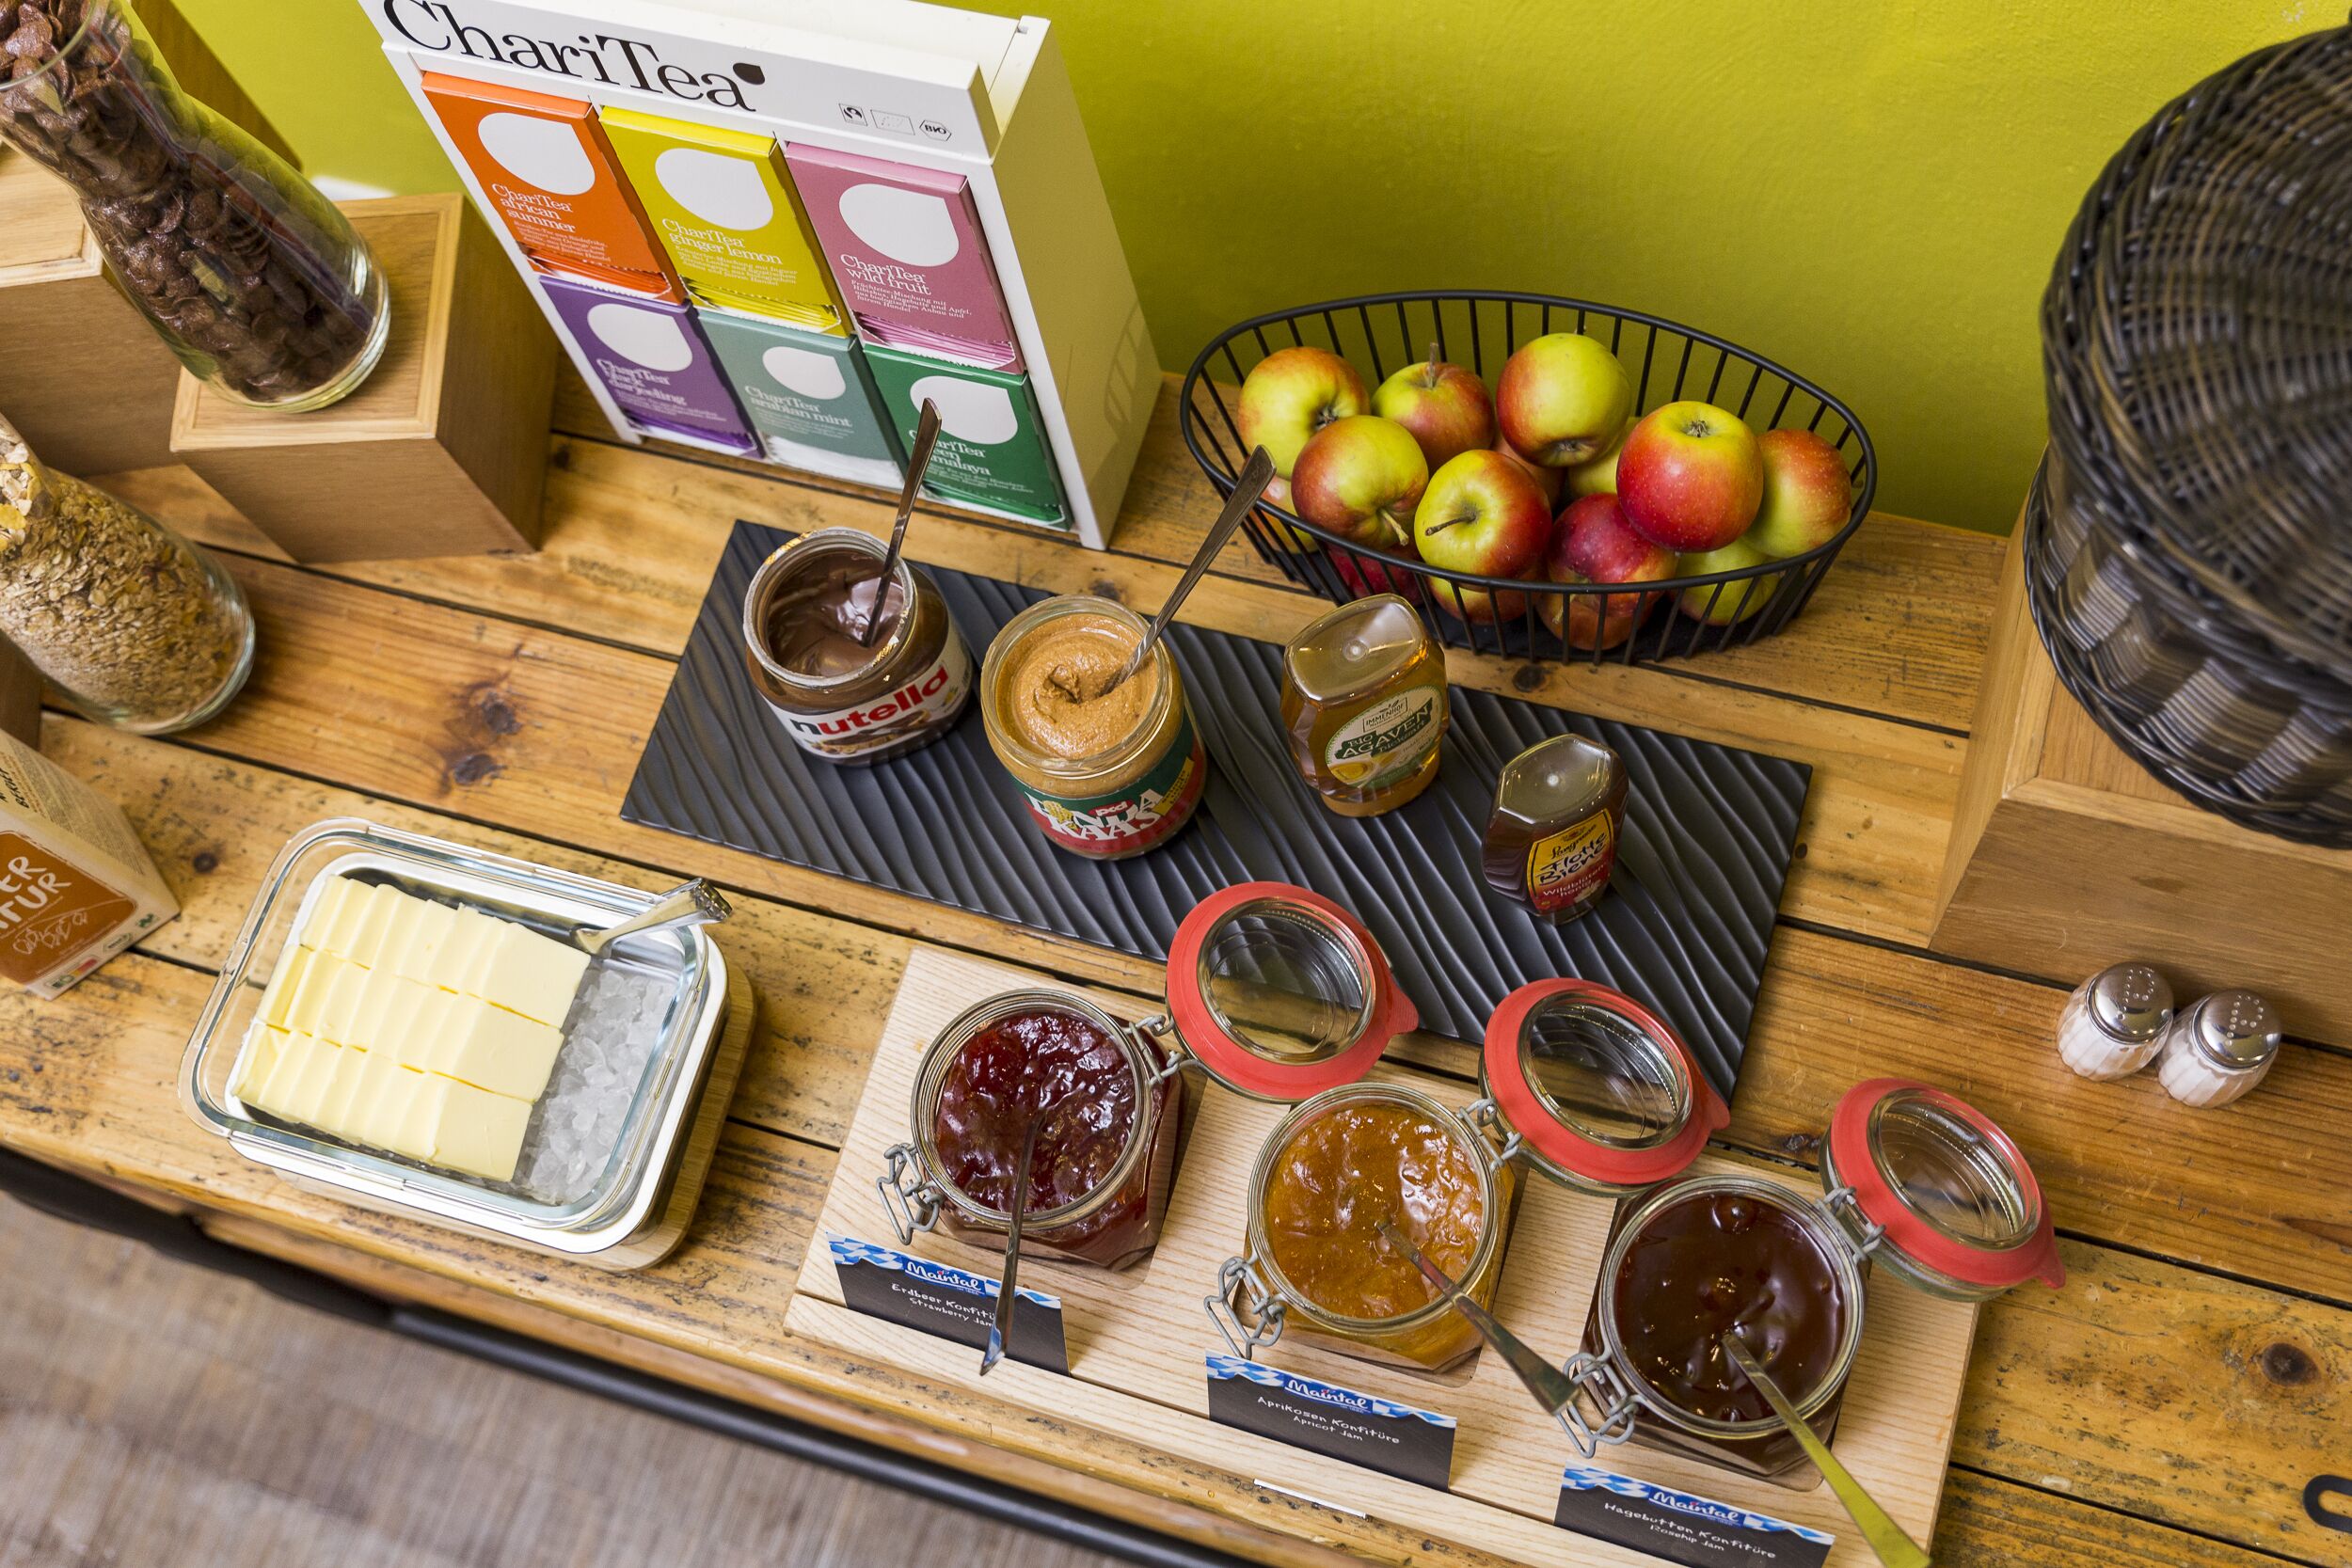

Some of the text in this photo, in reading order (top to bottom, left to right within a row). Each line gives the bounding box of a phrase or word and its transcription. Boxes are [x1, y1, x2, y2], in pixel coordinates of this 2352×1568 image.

[384, 0, 756, 112] ChariTea
[491, 183, 573, 213] ChariTea
[500, 197, 562, 220] african
[506, 209, 576, 233] summer
[662, 218, 744, 248] ChariTea
[669, 232, 783, 265] ginger lemon
[840, 253, 926, 284] ChariTea
[846, 268, 931, 296] wild fruit
[883, 301, 911, 313] Handel
[921, 307, 946, 315] Anbau
[745, 386, 821, 413] ChariTea
[811, 412, 853, 428] mint
[790, 666, 949, 736] nutella
[1343, 705, 1428, 758] AGAVEN
[1046, 809, 1162, 841] KAAS
[1535, 843, 1606, 886] Biene
[1540, 832, 1607, 871] Flotte
[0, 873, 72, 929] TUR
[907, 1261, 982, 1291] Maintal
[892, 1282, 942, 1305] Erdbeer
[946, 1300, 995, 1321] Konfitü
[910, 1297, 970, 1322] Strawberry
[1288, 1380, 1369, 1409] Maintal
[1257, 1396, 1400, 1444] Aprikosen Konfitüre
[1294, 1416, 1363, 1441] Apricot Jam
[1653, 1492, 1740, 1522] Maintal
[1604, 1502, 1776, 1559] Hagebutten Konfitüre
[1649, 1524, 1724, 1551] Rosehip Jam
